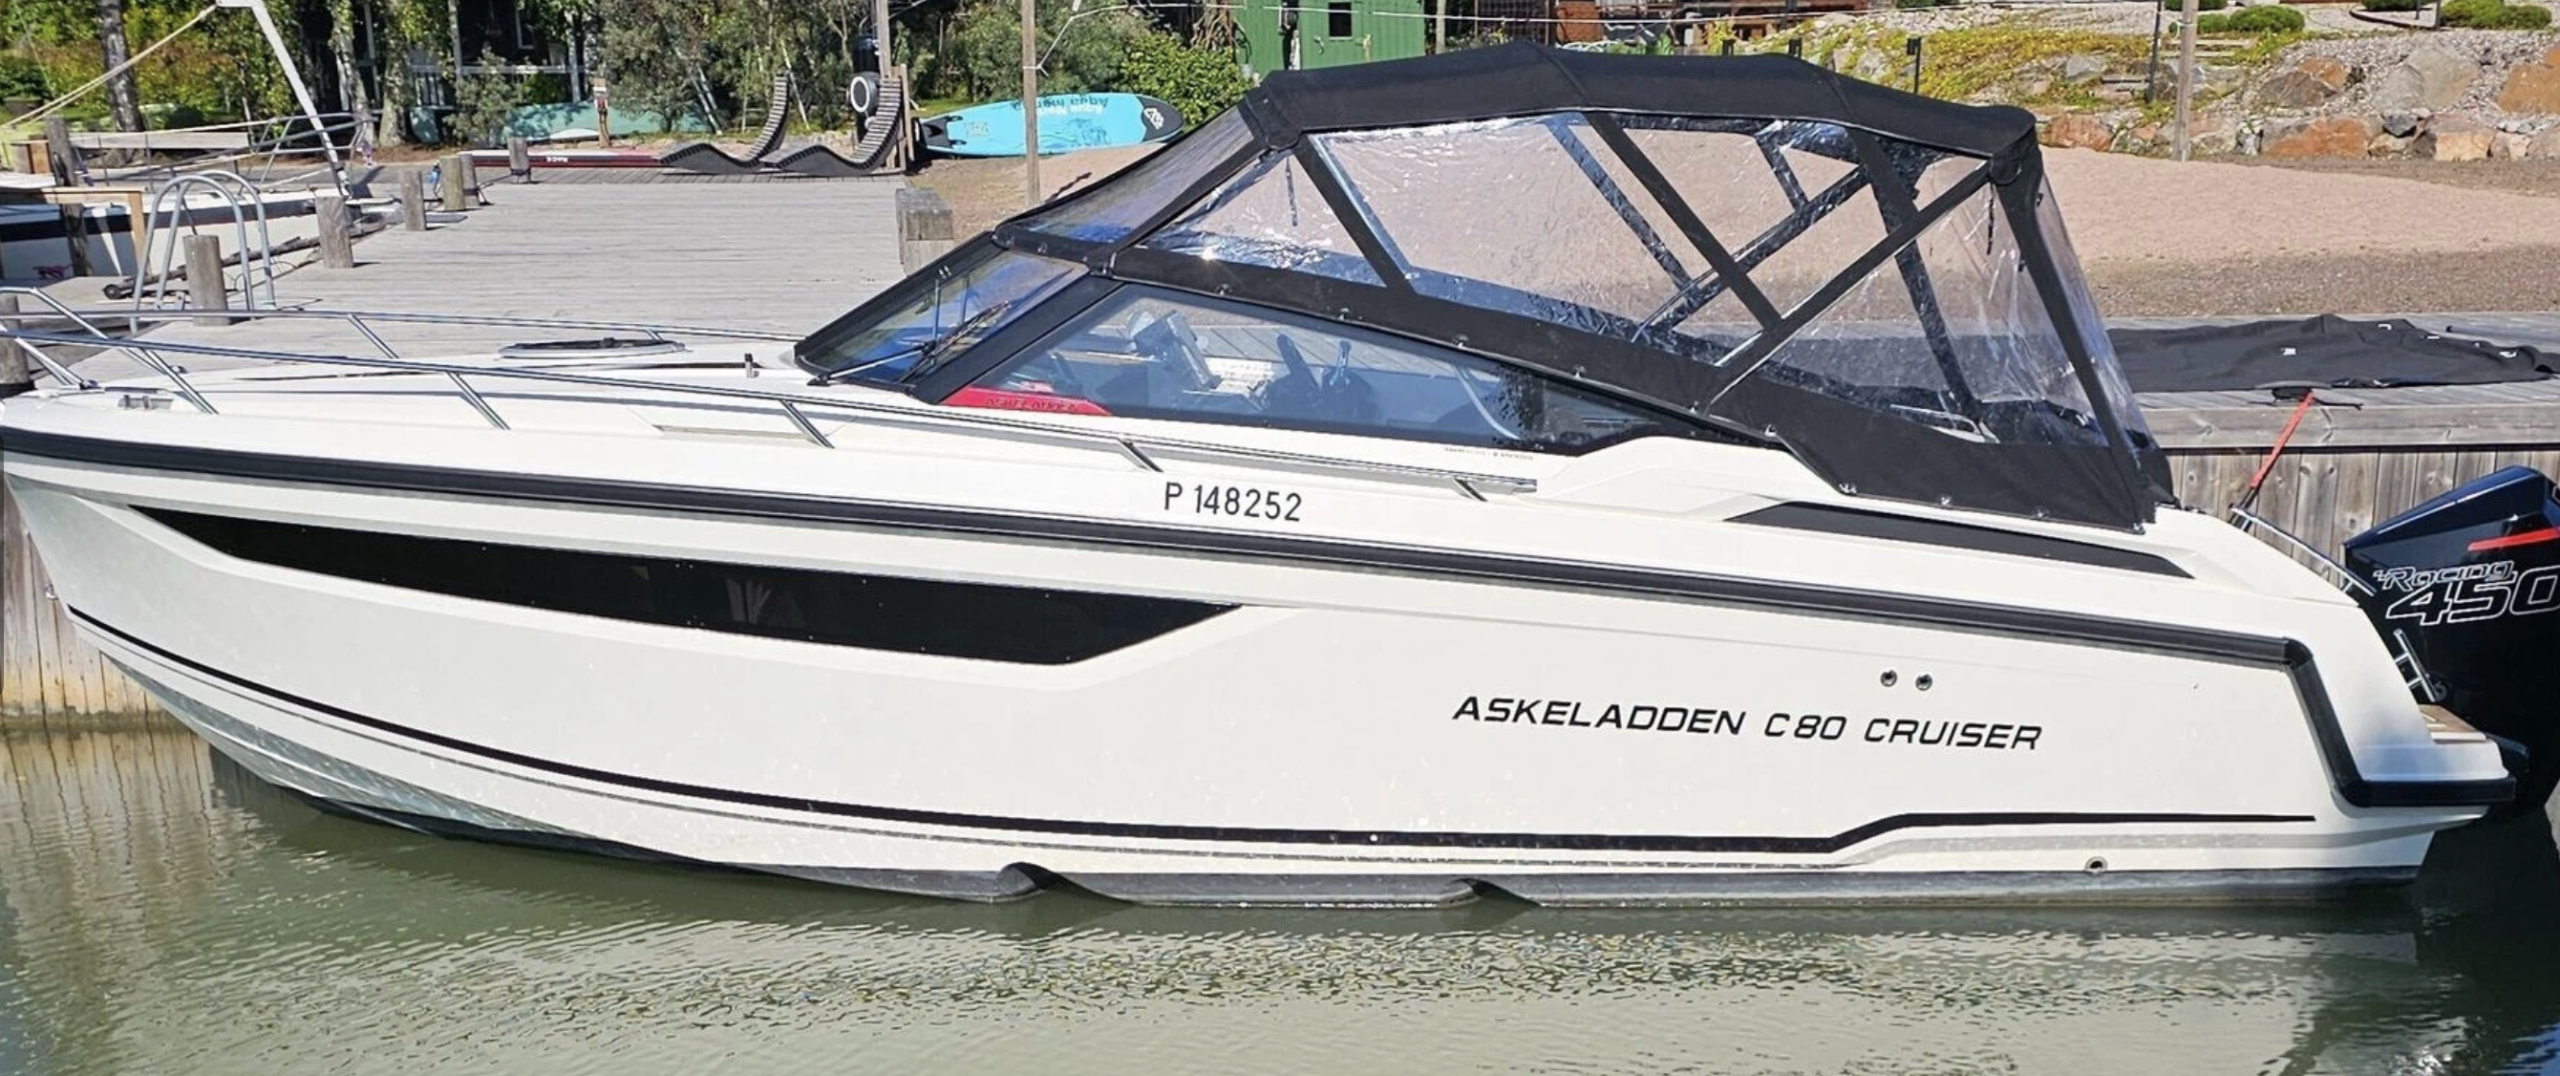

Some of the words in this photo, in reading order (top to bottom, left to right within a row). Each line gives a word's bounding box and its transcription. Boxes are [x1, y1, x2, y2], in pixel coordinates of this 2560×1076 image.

[1165, 481, 1183, 510] P
[1194, 484, 1302, 522] 148252
[2373, 560, 2515, 592] Racing
[2385, 564, 2560, 626] 450
[1452, 696, 1746, 735] ASKELADDEN
[1864, 717, 2043, 751] CRUISER
